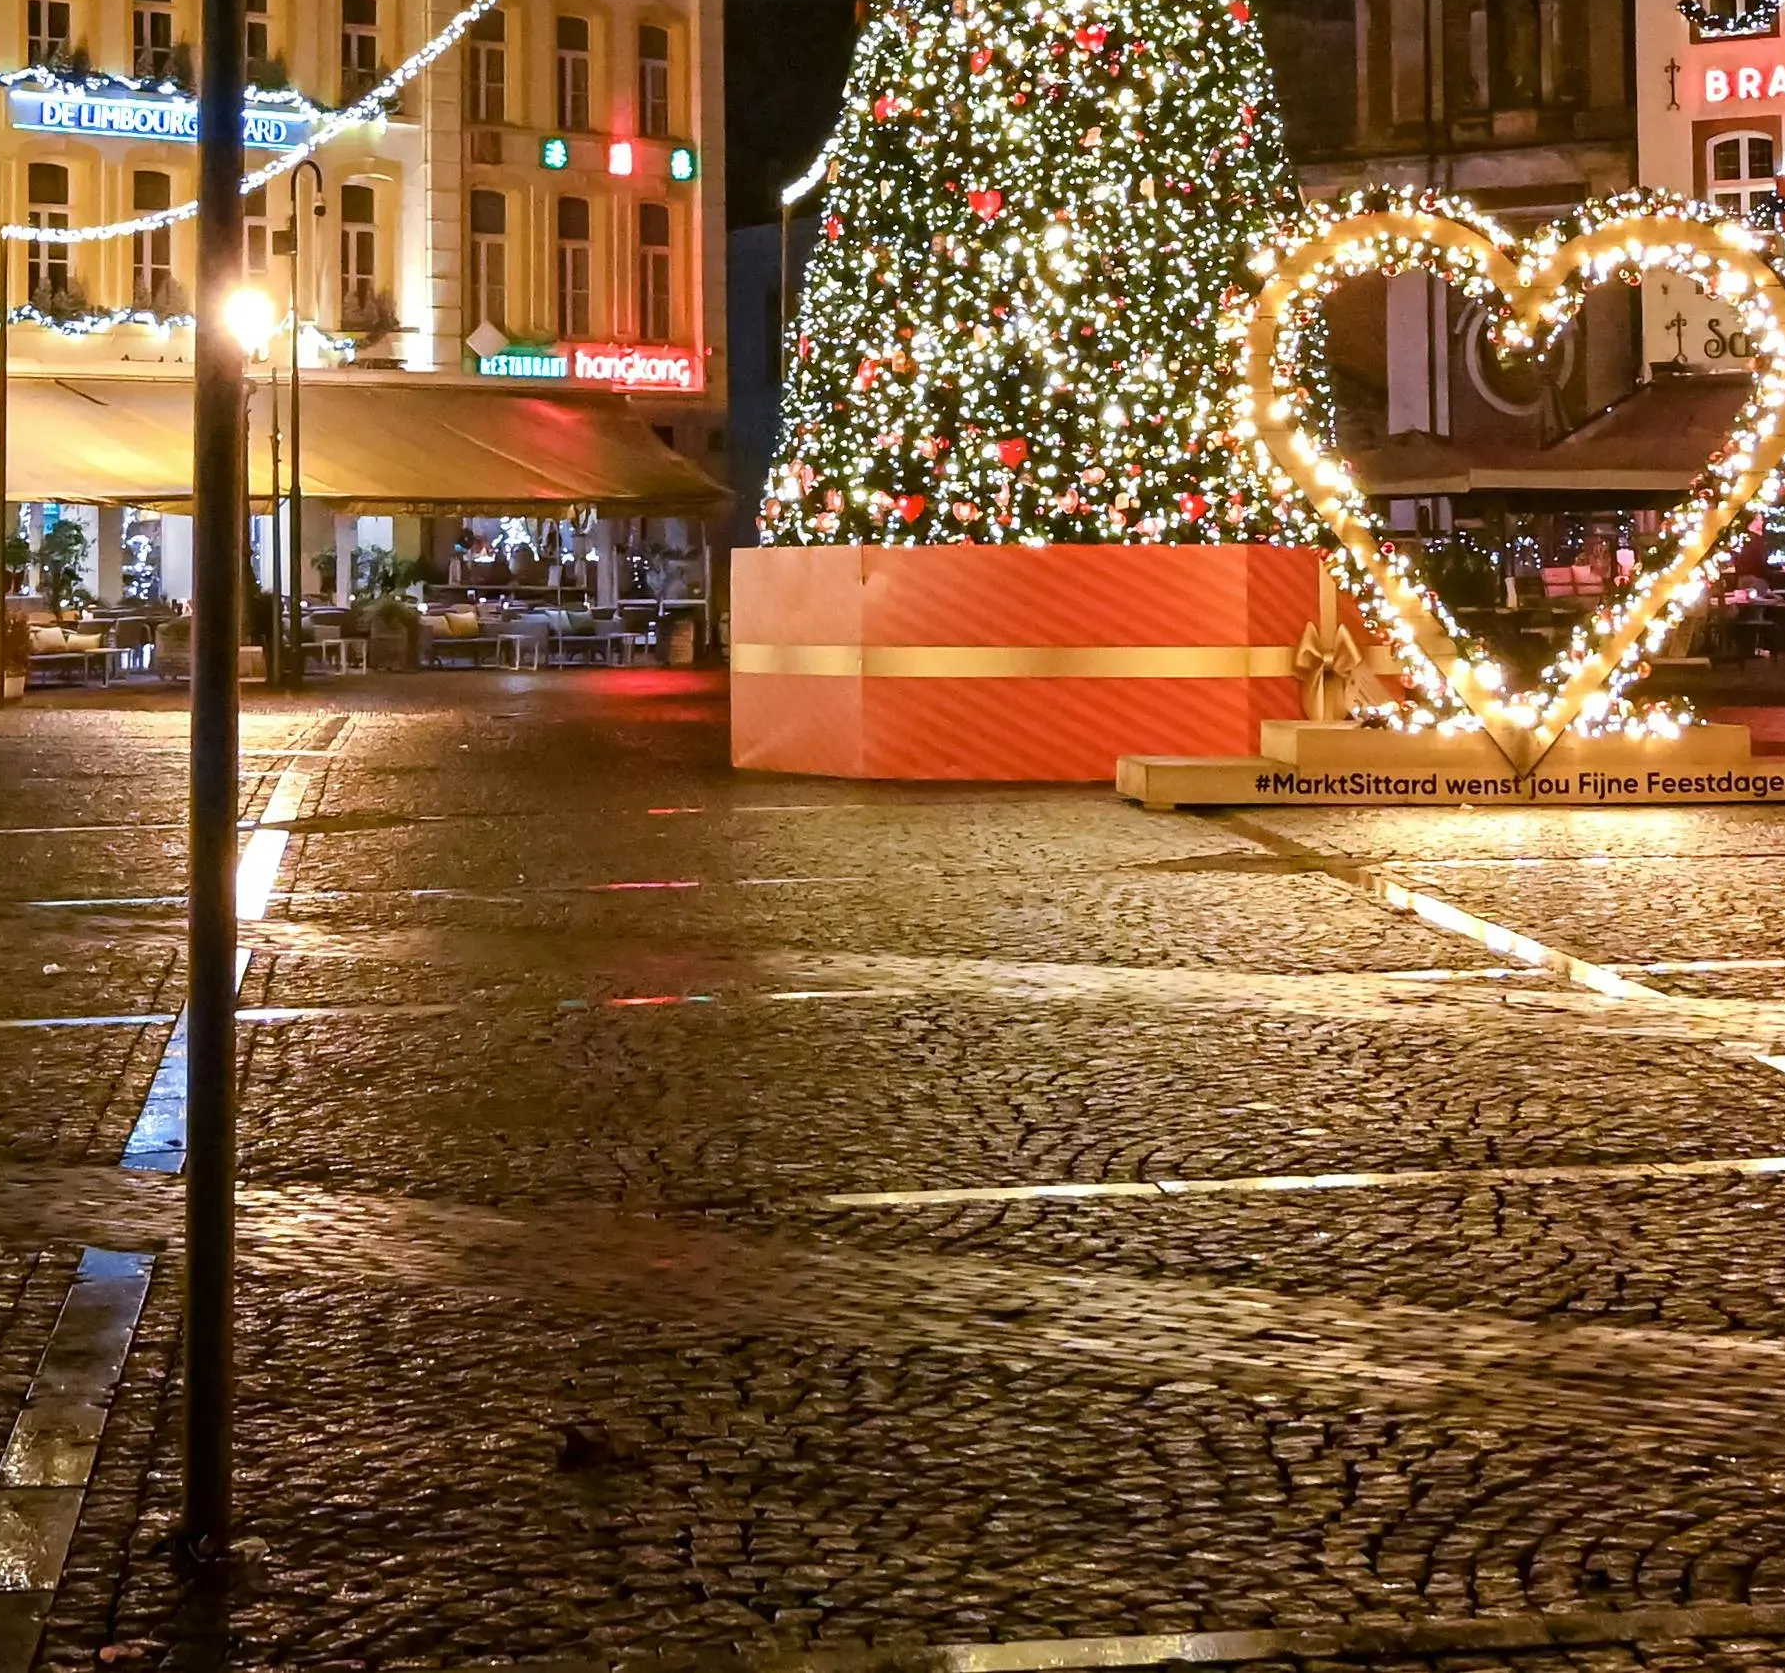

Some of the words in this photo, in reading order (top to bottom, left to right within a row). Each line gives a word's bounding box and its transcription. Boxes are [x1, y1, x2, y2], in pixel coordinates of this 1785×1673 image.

[41, 101, 76, 126] DE
[480, 355, 568, 377] RESTAURANT
[1255, 773, 1437, 795] #MarktSittard
[1445, 775, 1522, 795] wenst
[1529, 773, 1569, 799] jou
[1579, 772, 1639, 799] Fijne
